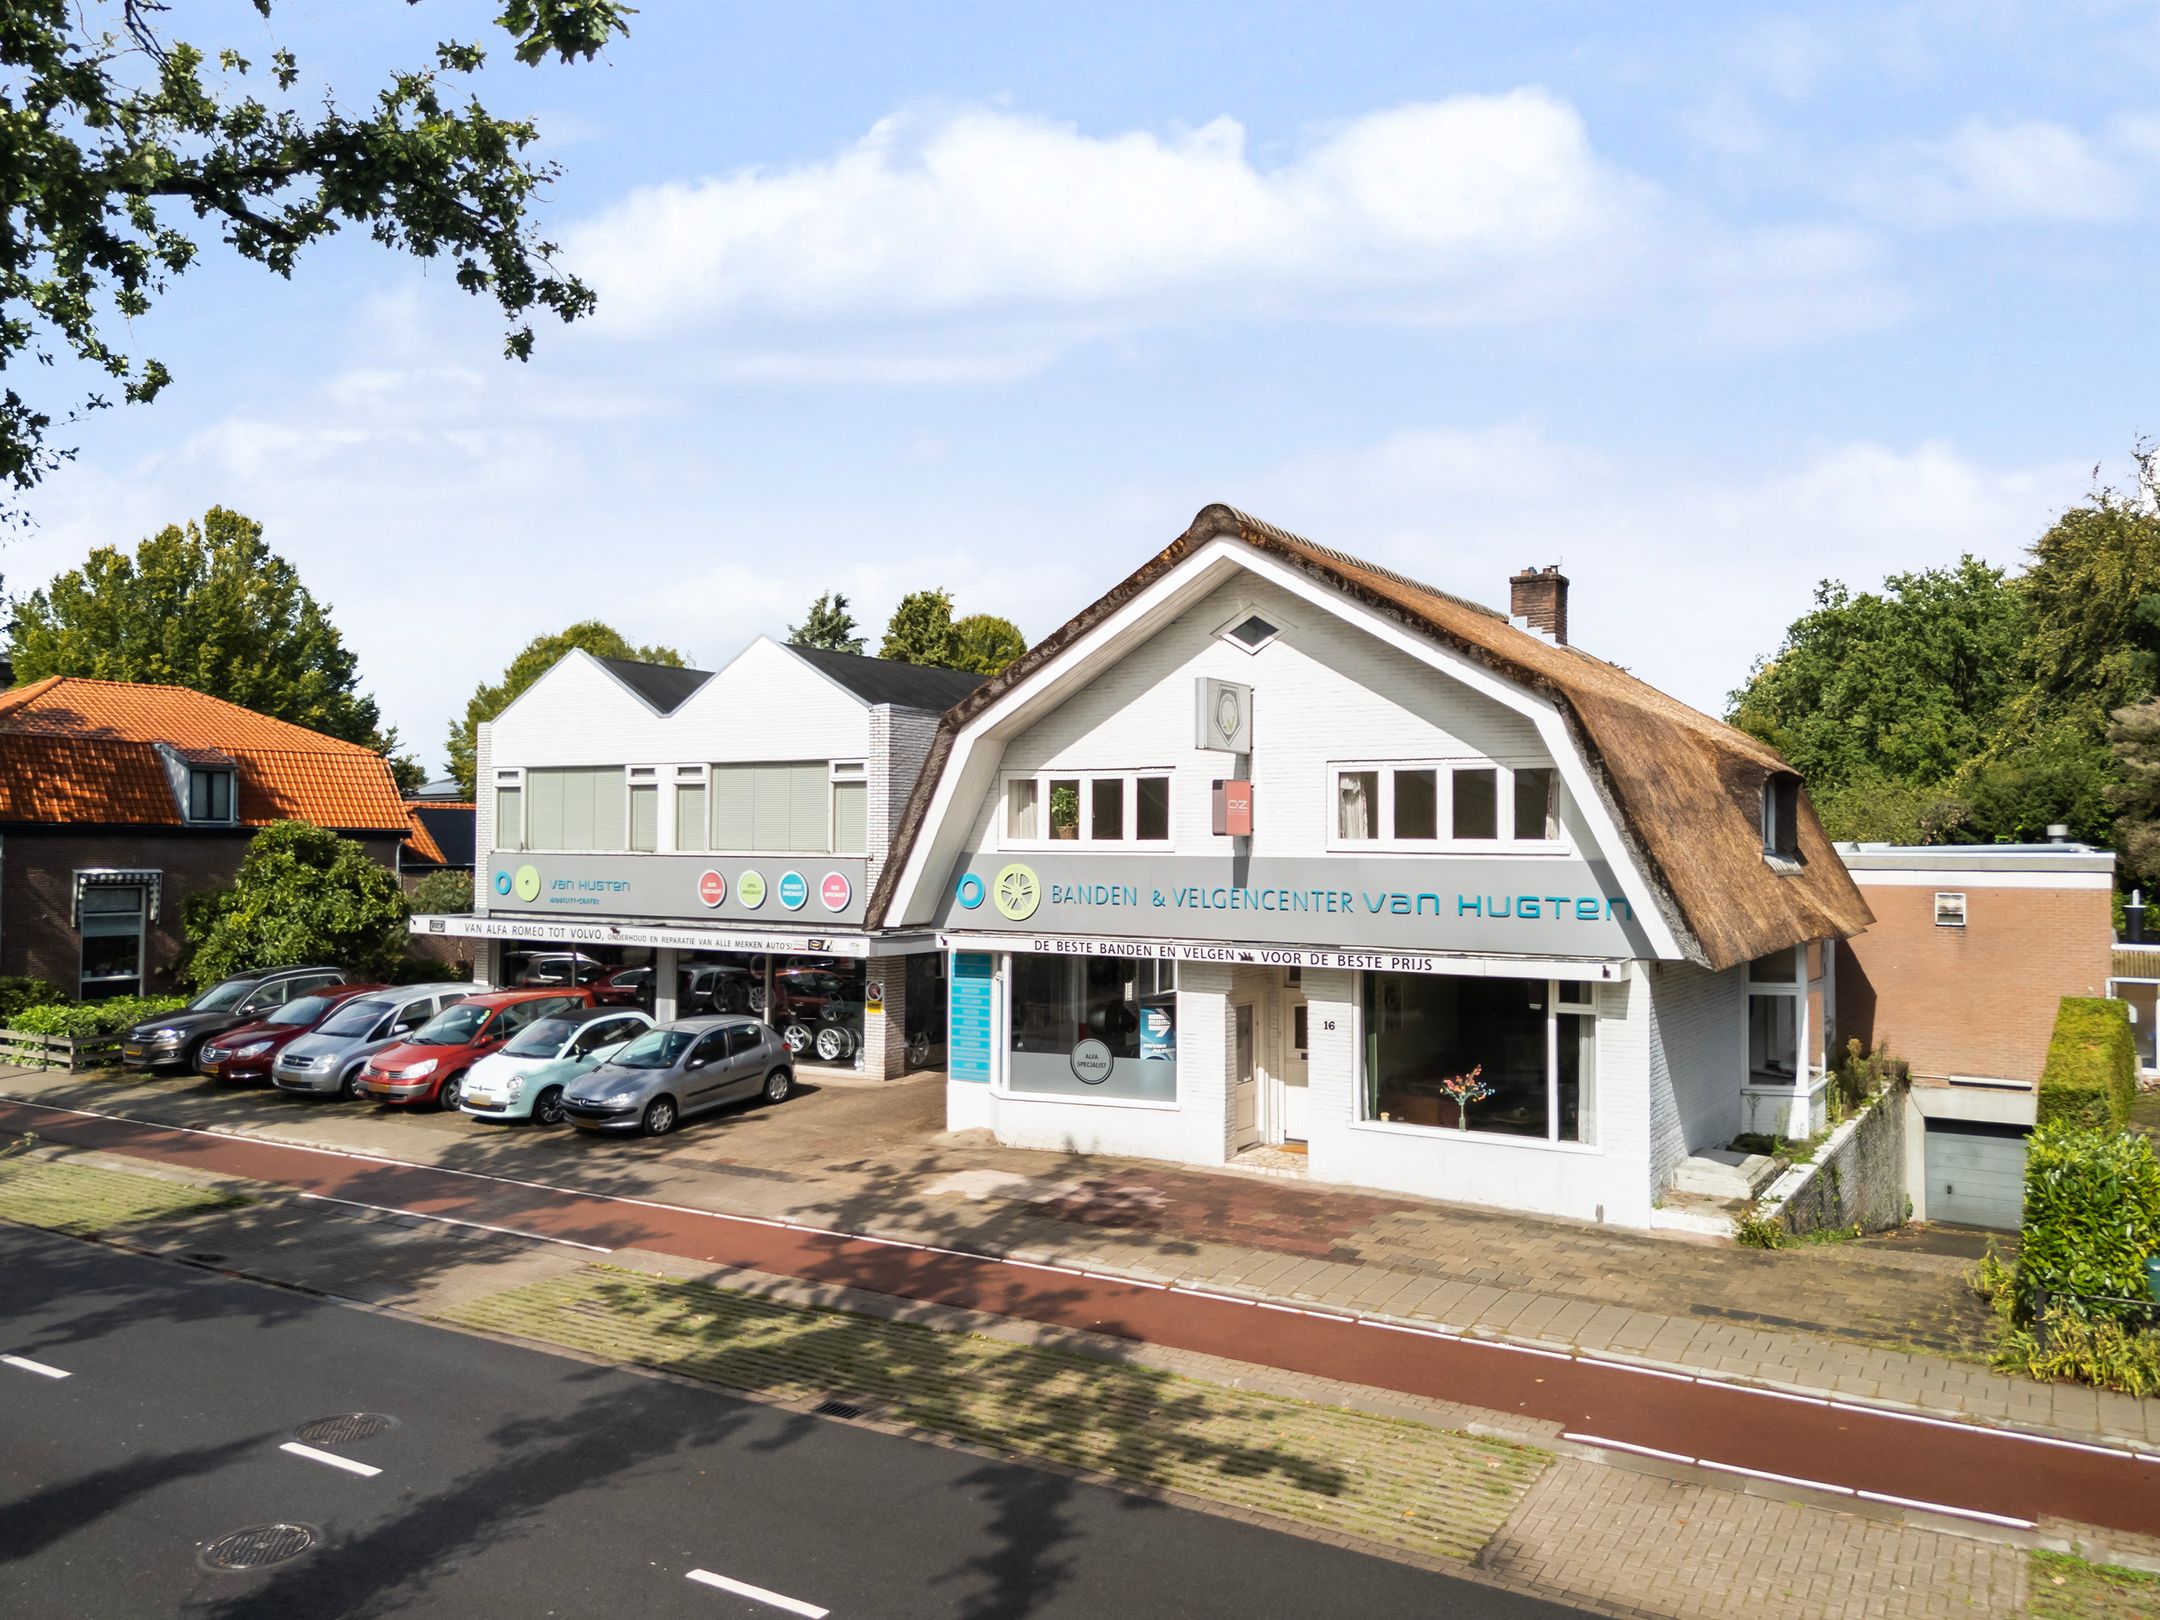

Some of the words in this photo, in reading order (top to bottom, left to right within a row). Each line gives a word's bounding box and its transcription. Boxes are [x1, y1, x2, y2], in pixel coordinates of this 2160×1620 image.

[1051, 884, 1138, 907] BANDEN
[1152, 889, 1166, 907] &
[1172, 887, 1353, 913] VELGENCENTER
[464, 923, 482, 933] VAN
[486, 924, 508, 934] ALFA
[512, 925, 544, 937] ROMEO
[548, 927, 566, 938] TOT
[571, 928, 604, 941] VOLVO,
[607, 933, 647, 942] ONDERHOUD
[661, 936, 695, 945] REPARATIE
[699, 938, 712, 946] VAN
[715, 939, 731, 947] ALLE
[734, 941, 763, 949] MERKEN
[1034, 940, 1049, 951] DE
[1057, 941, 1093, 954] BESTE
[1100, 943, 1152, 957] BANDEN
[1160, 945, 1176, 958] EN
[1183, 946, 1235, 961] VELGEN
[1261, 951, 1302, 965] VOOR
[1310, 953, 1329, 966] DE
[1337, 955, 1383, 969] BESTE
[1391, 957, 1433, 971] PRIJS
[1323, 1020, 1336, 1031] 16
[1077, 1061, 1107, 1069] SPECIALIST
